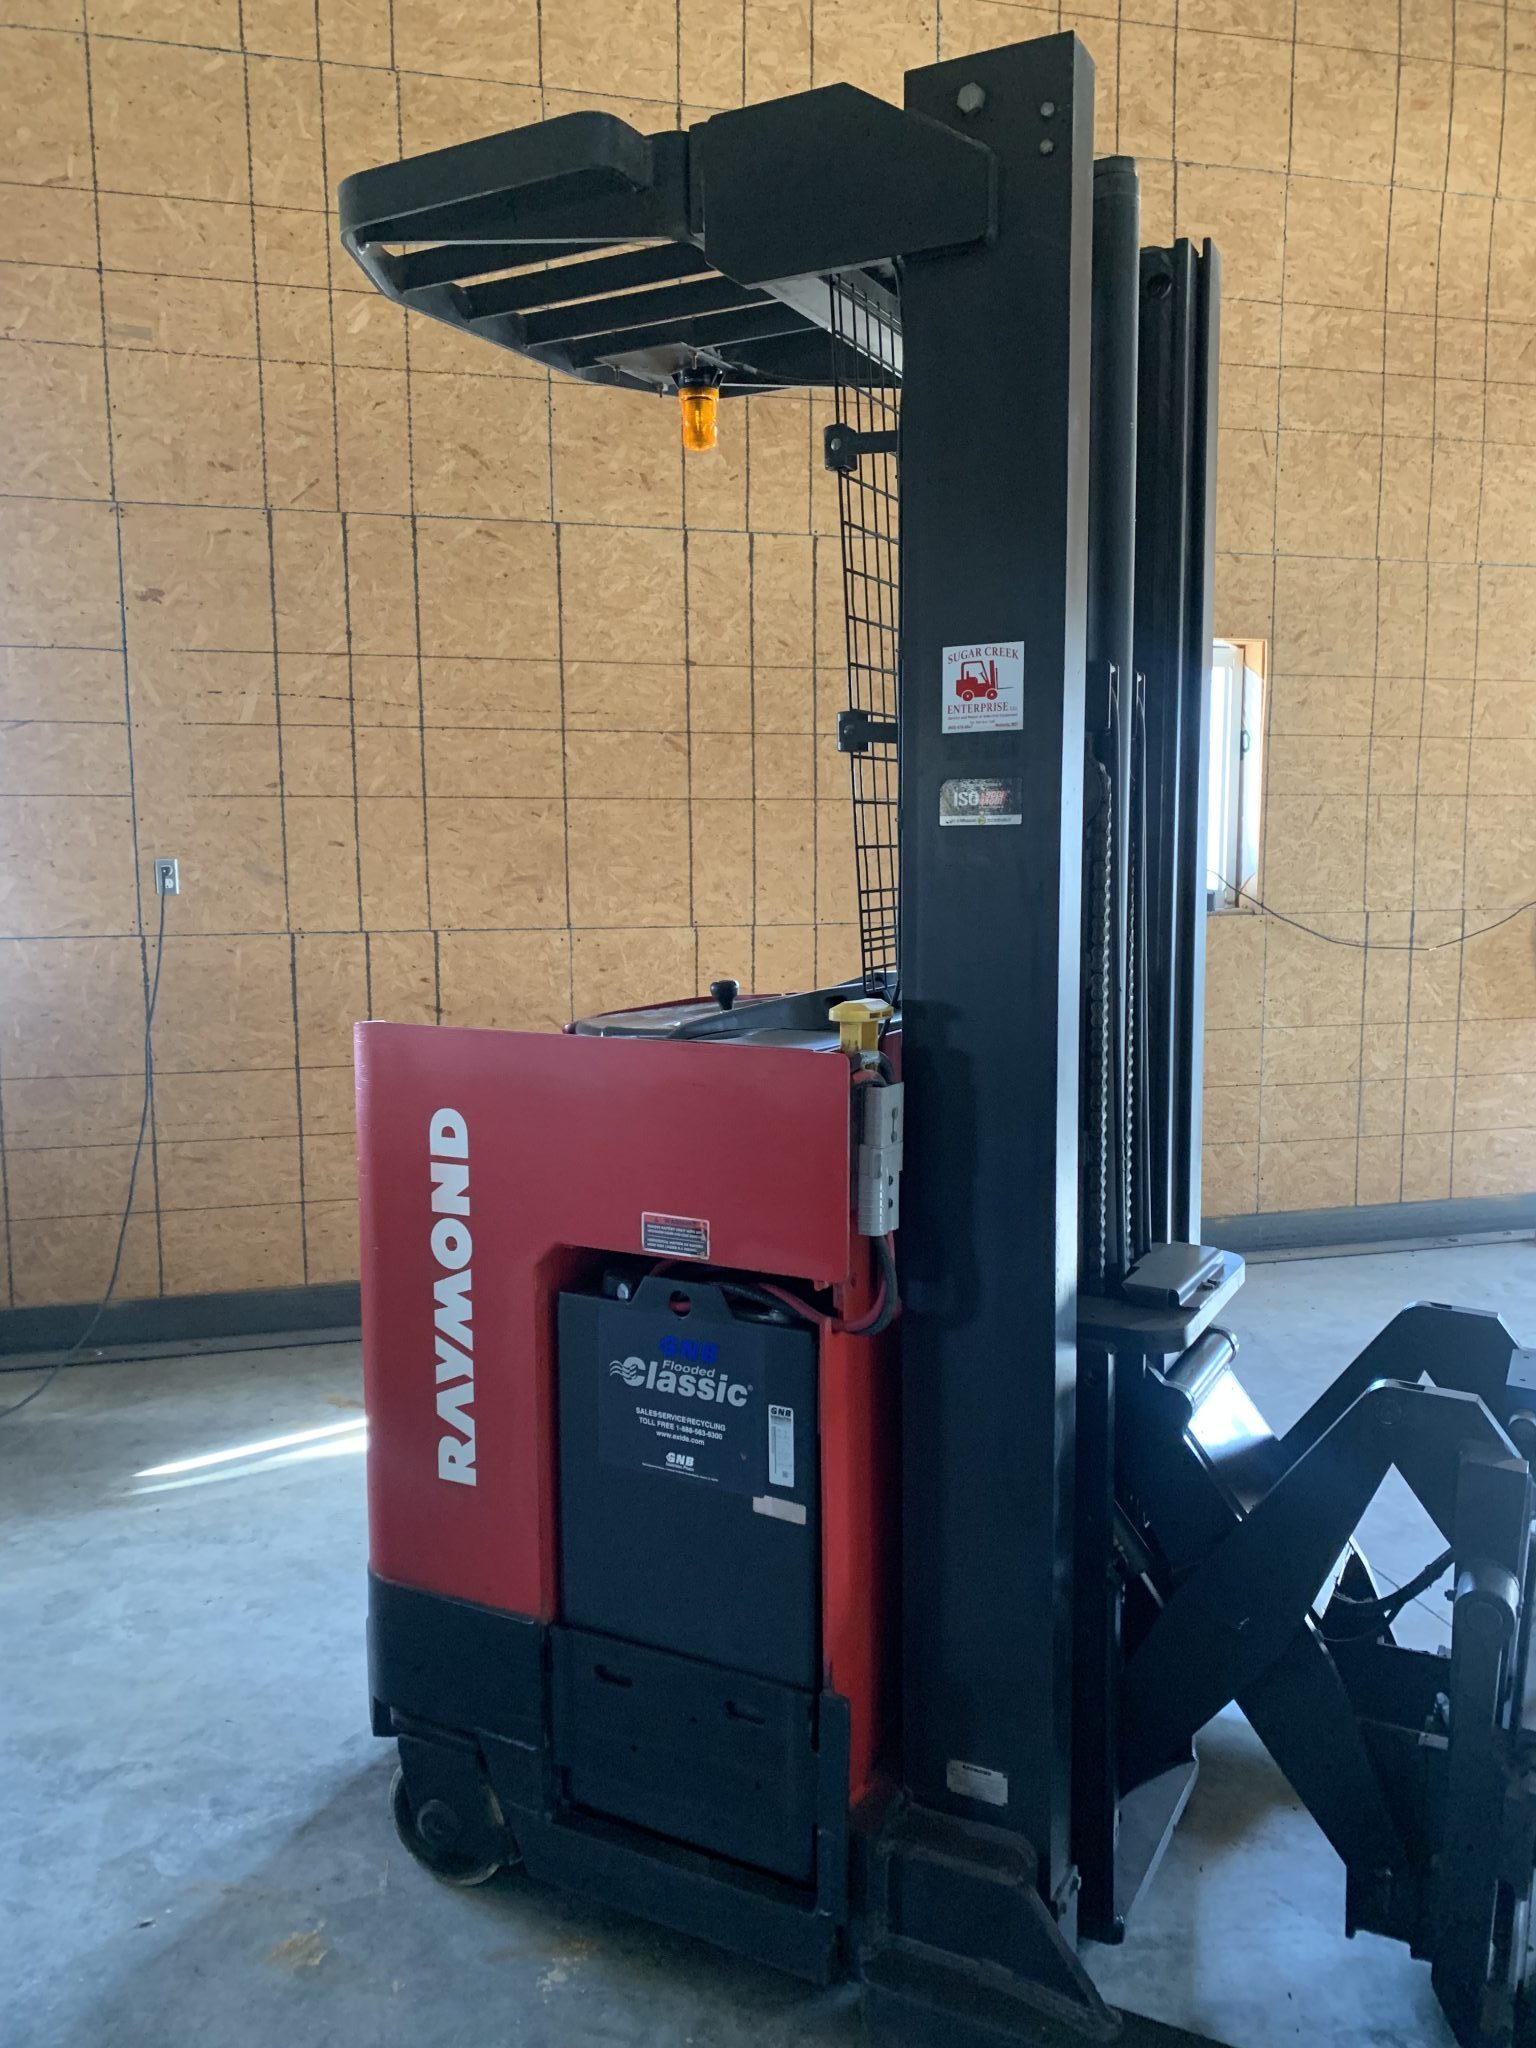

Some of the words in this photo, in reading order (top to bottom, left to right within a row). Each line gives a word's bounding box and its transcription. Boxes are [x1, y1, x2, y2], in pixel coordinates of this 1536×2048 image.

[948, 647, 982, 664] SUGAR
[984, 646, 1019, 660] CREEK
[947, 702, 1009, 714] ENTERPRISE
[430, 1108, 477, 1486] RAYMOND
[659, 1335, 718, 1364] GNB
[662, 1360, 716, 1378] Flooded
[611, 1356, 748, 1407] Classic
[771, 1406, 792, 1417] GNB
[639, 1416, 656, 1427] TOLL
[657, 1420, 675, 1431] FREE
[656, 1431, 705, 1446] www.exide.com
[665, 1451, 695, 1467] GNB
